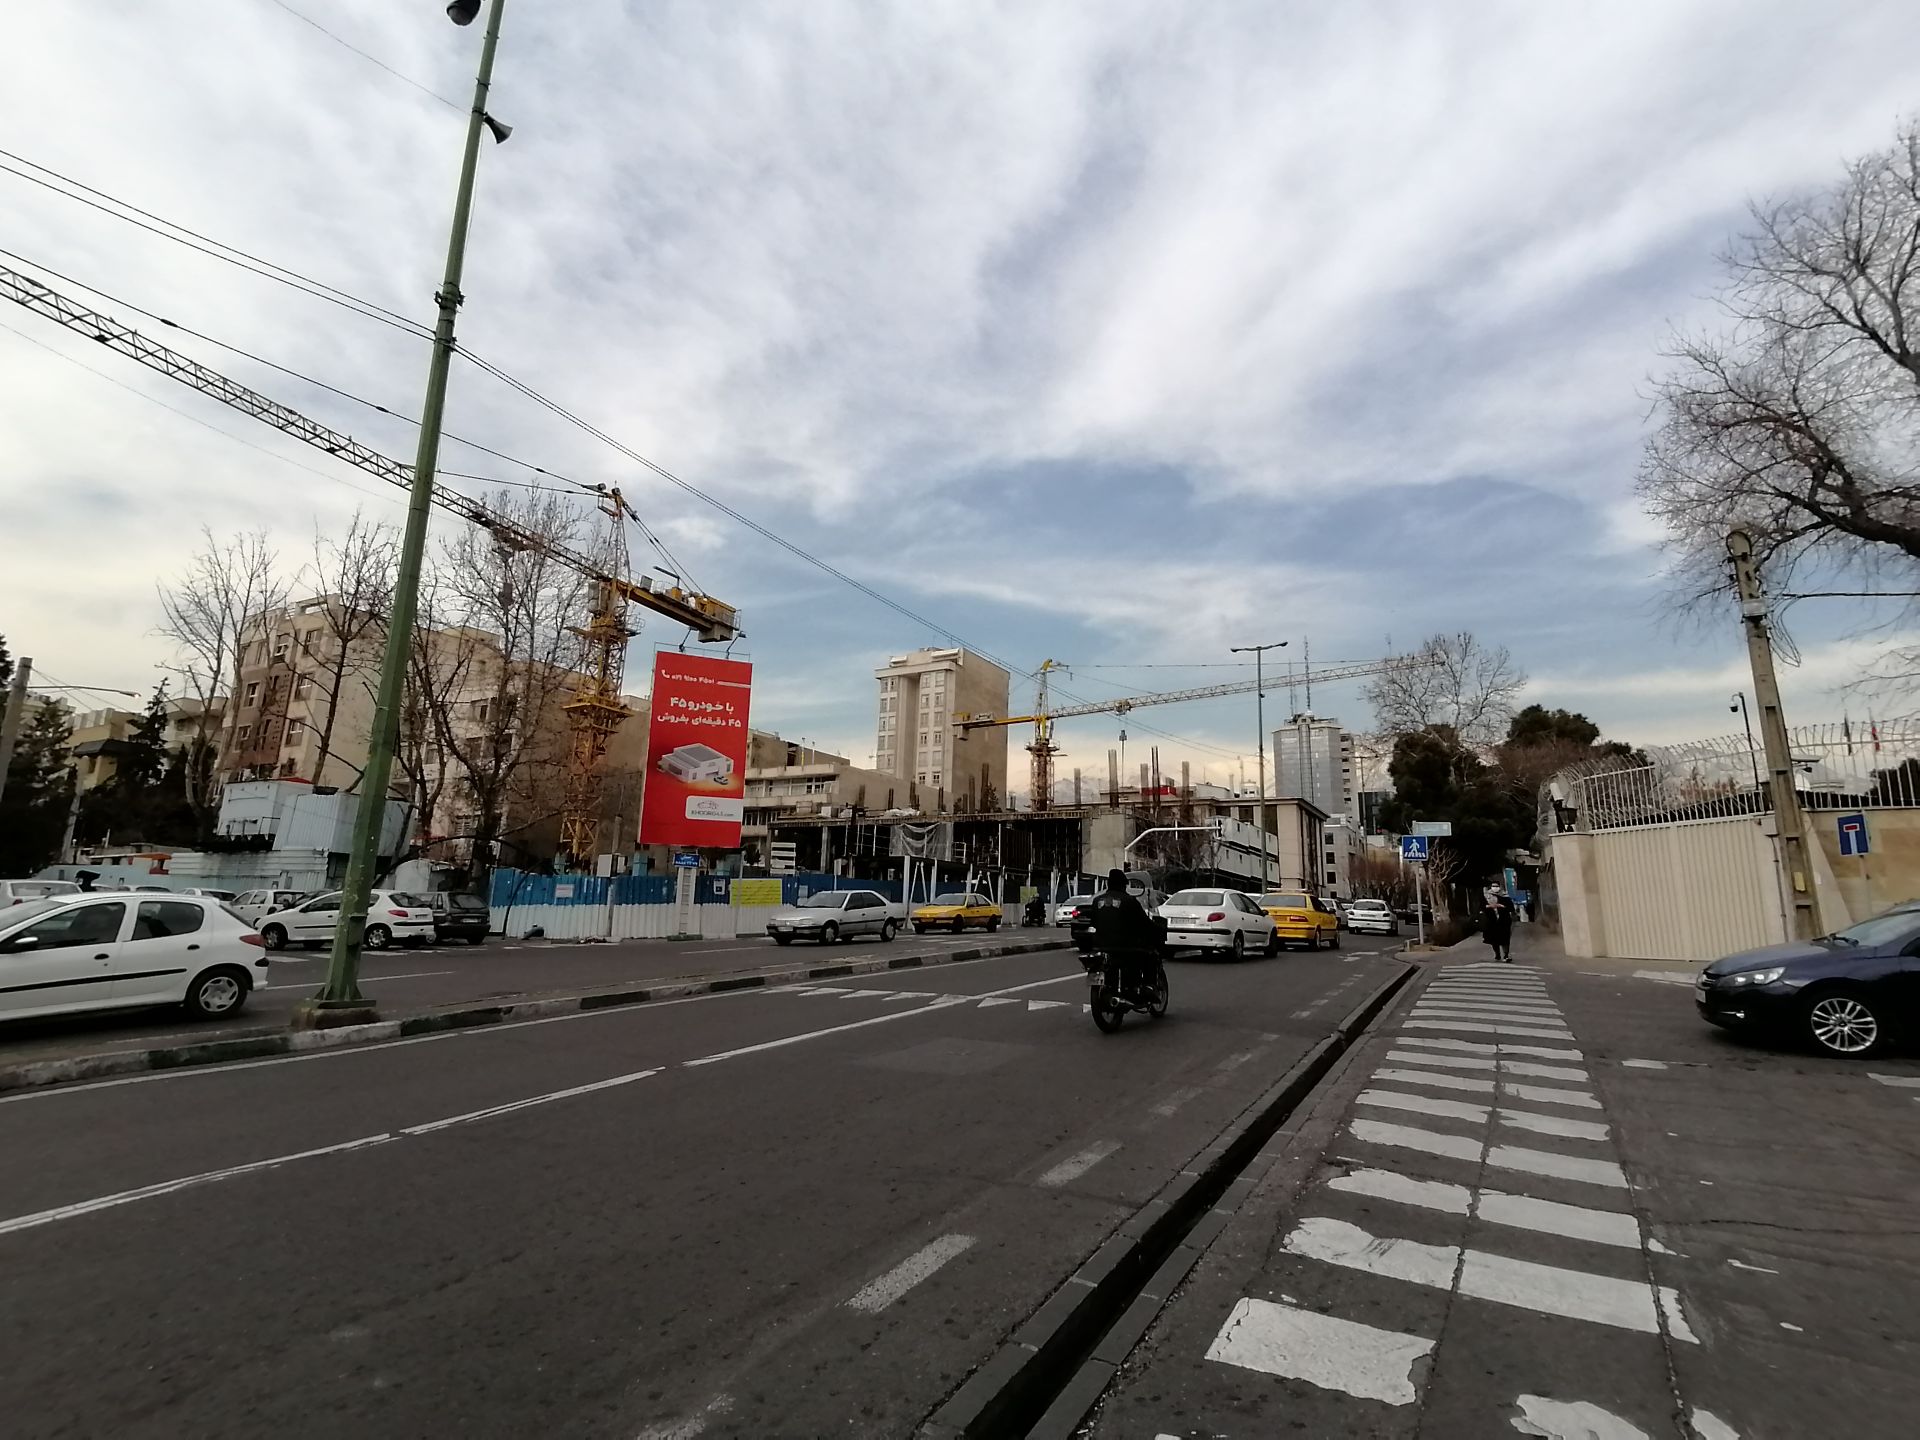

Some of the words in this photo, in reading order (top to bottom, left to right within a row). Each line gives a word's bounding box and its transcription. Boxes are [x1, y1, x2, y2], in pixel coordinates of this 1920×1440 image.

[725, 702, 734, 714] با
[657, 712, 689, 724] بفروش
[728, 719, 741, 727] ۴۵
